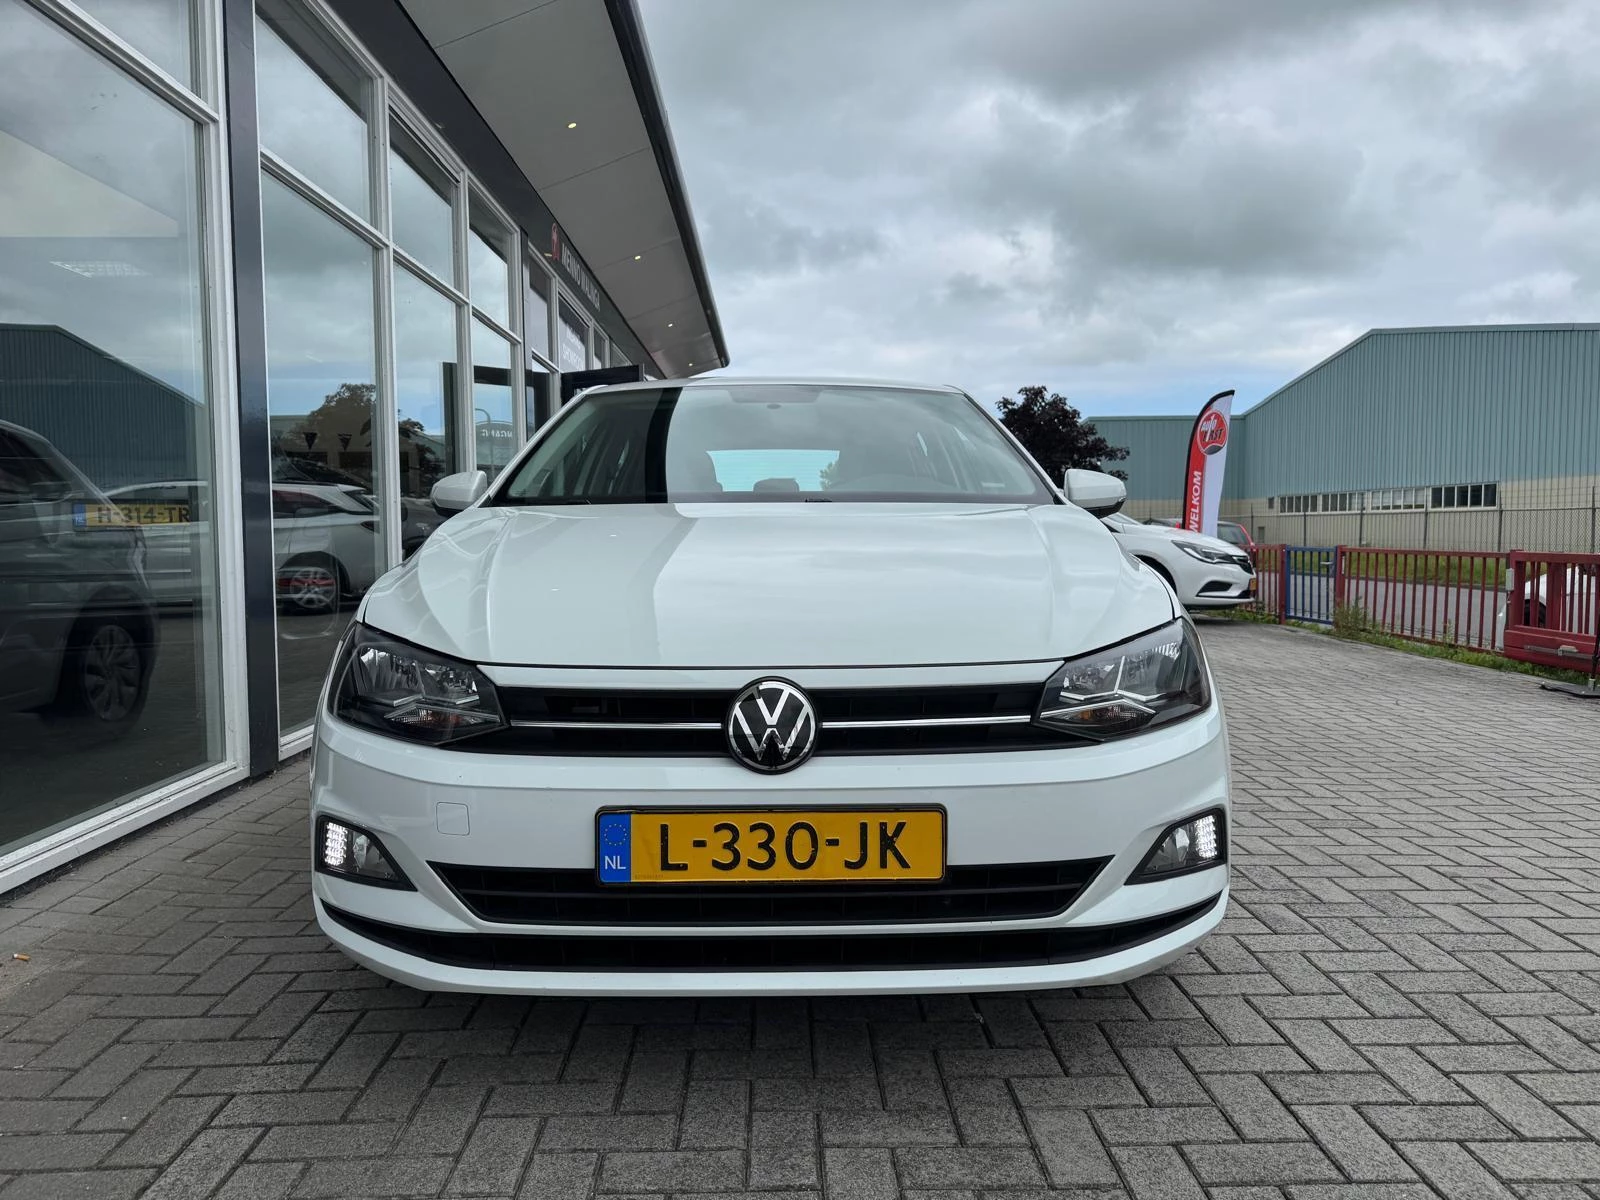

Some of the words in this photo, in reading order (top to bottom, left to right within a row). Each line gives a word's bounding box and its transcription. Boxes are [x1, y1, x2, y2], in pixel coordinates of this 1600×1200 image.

[97, 506, 191, 524] H-314-TR
[1189, 470, 1202, 533] WELKOM
[604, 855, 627, 870] NL
[659, 821, 911, 872] L-330-JK
